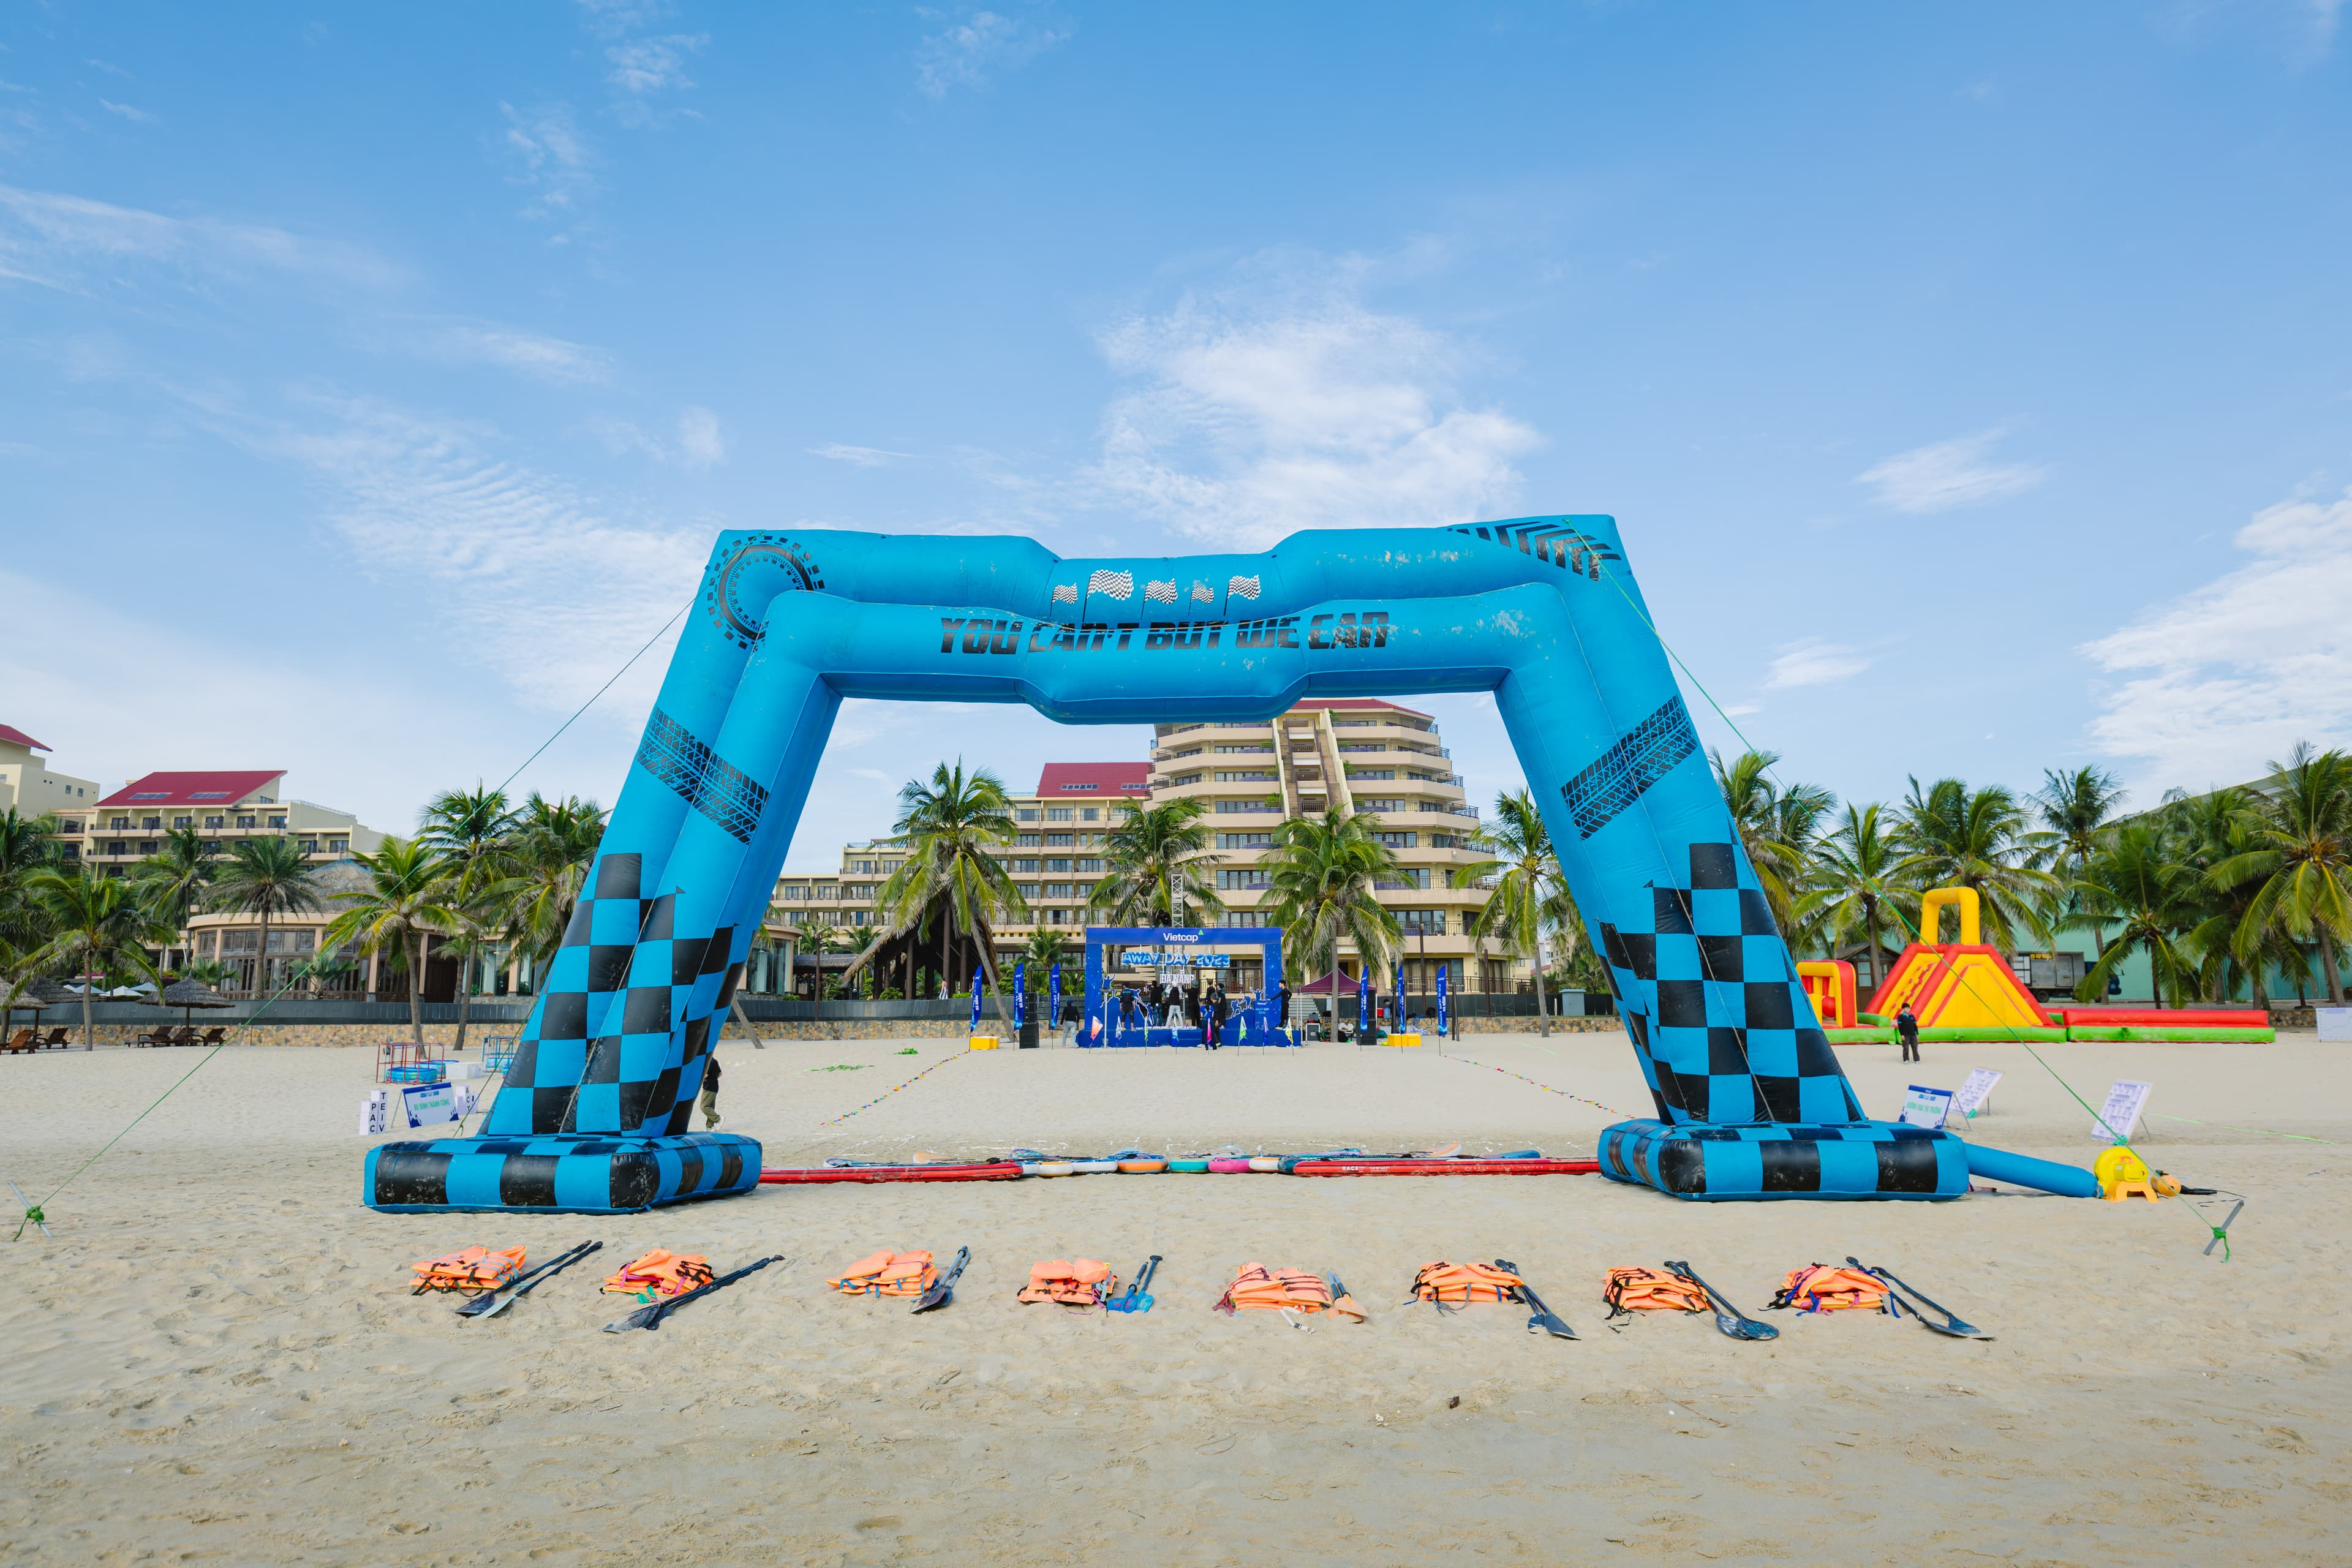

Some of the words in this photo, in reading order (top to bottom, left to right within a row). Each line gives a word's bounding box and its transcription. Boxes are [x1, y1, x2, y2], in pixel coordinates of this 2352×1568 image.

[941, 618, 1023, 654] YOU
[1145, 620, 1228, 650] BUT
[1236, 616, 1301, 649] WE
[1309, 611, 1389, 649] CAN
[1163, 932, 1199, 943] Vietcap
[1123, 952, 1161, 965] AWAY
[1164, 952, 1192, 966] DAY
